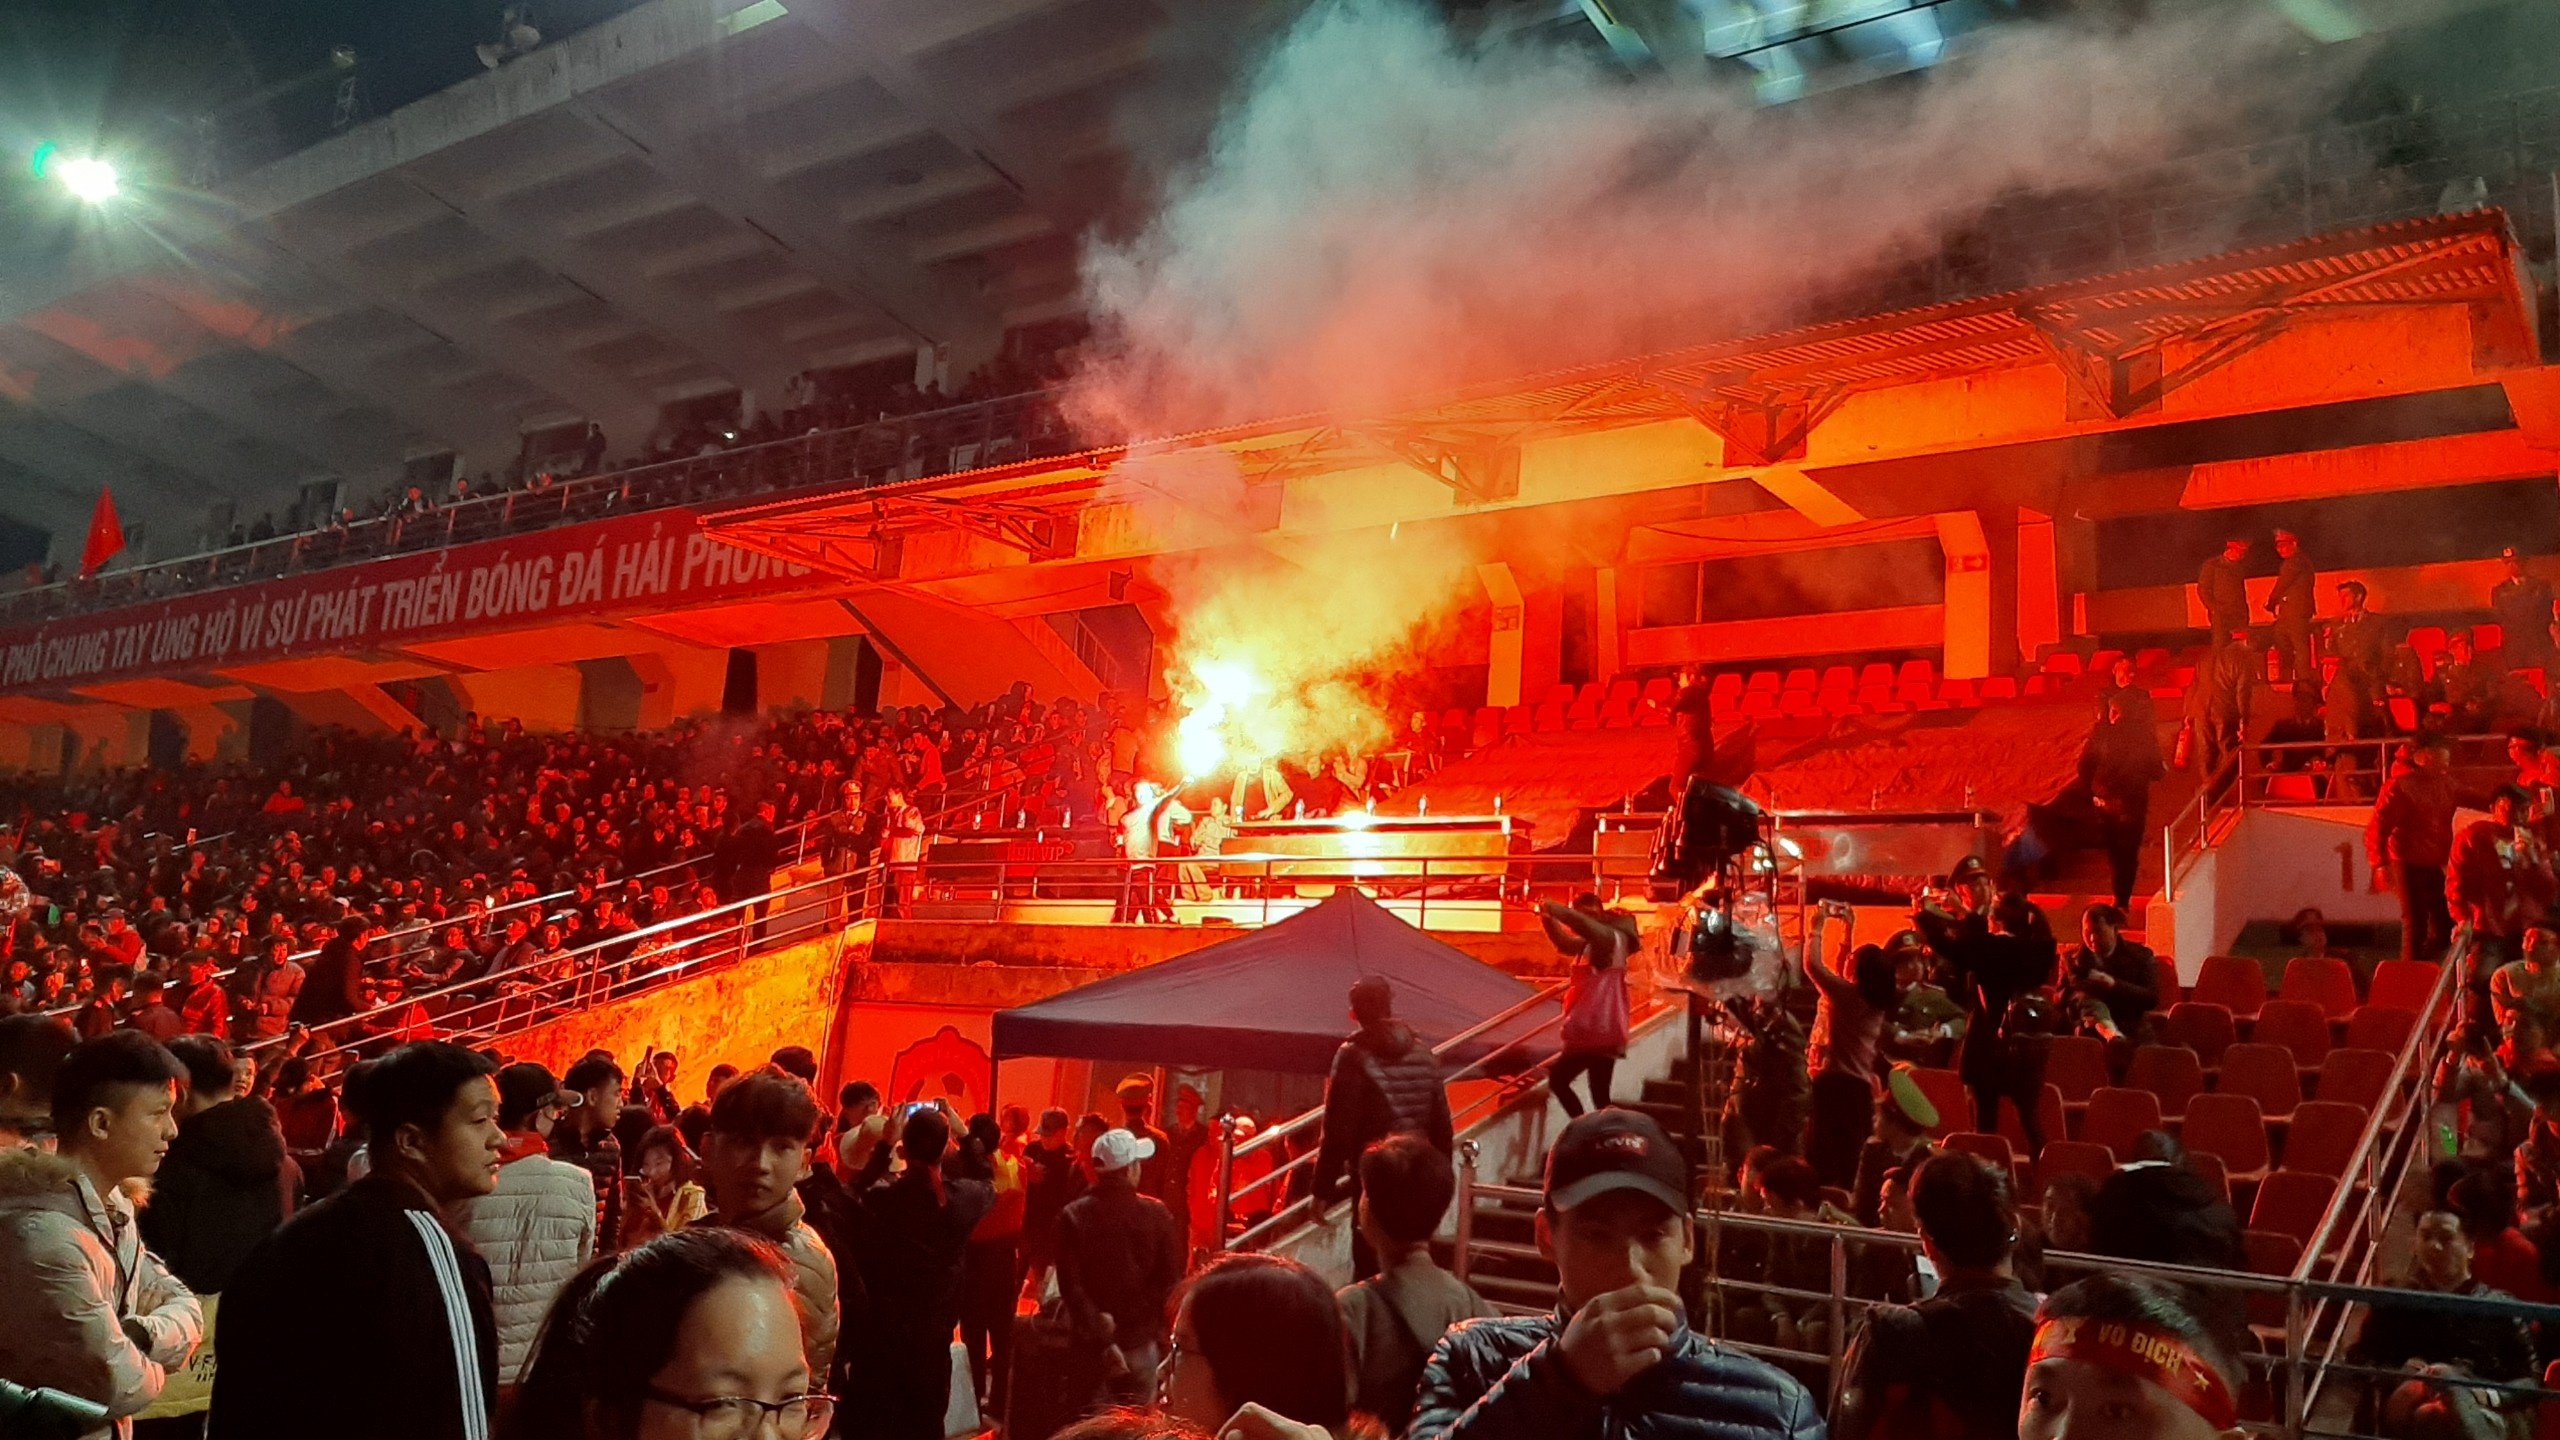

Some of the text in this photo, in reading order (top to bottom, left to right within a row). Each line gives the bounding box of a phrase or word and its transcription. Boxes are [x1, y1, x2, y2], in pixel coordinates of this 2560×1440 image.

[43, 628, 109, 678] CHUNG
[111, 622, 152, 668] TAY
[199, 597, 236, 662] HỘ
[239, 591, 267, 651] VÌ
[265, 589, 307, 654] SỰ
[304, 576, 377, 641] PHÁT
[380, 550, 462, 631] TRIỂN
[465, 550, 554, 620] BÓNG
[558, 534, 606, 606] ĐÁ
[611, 522, 675, 598] HẢI
[2334, 842, 2353, 891] 1
